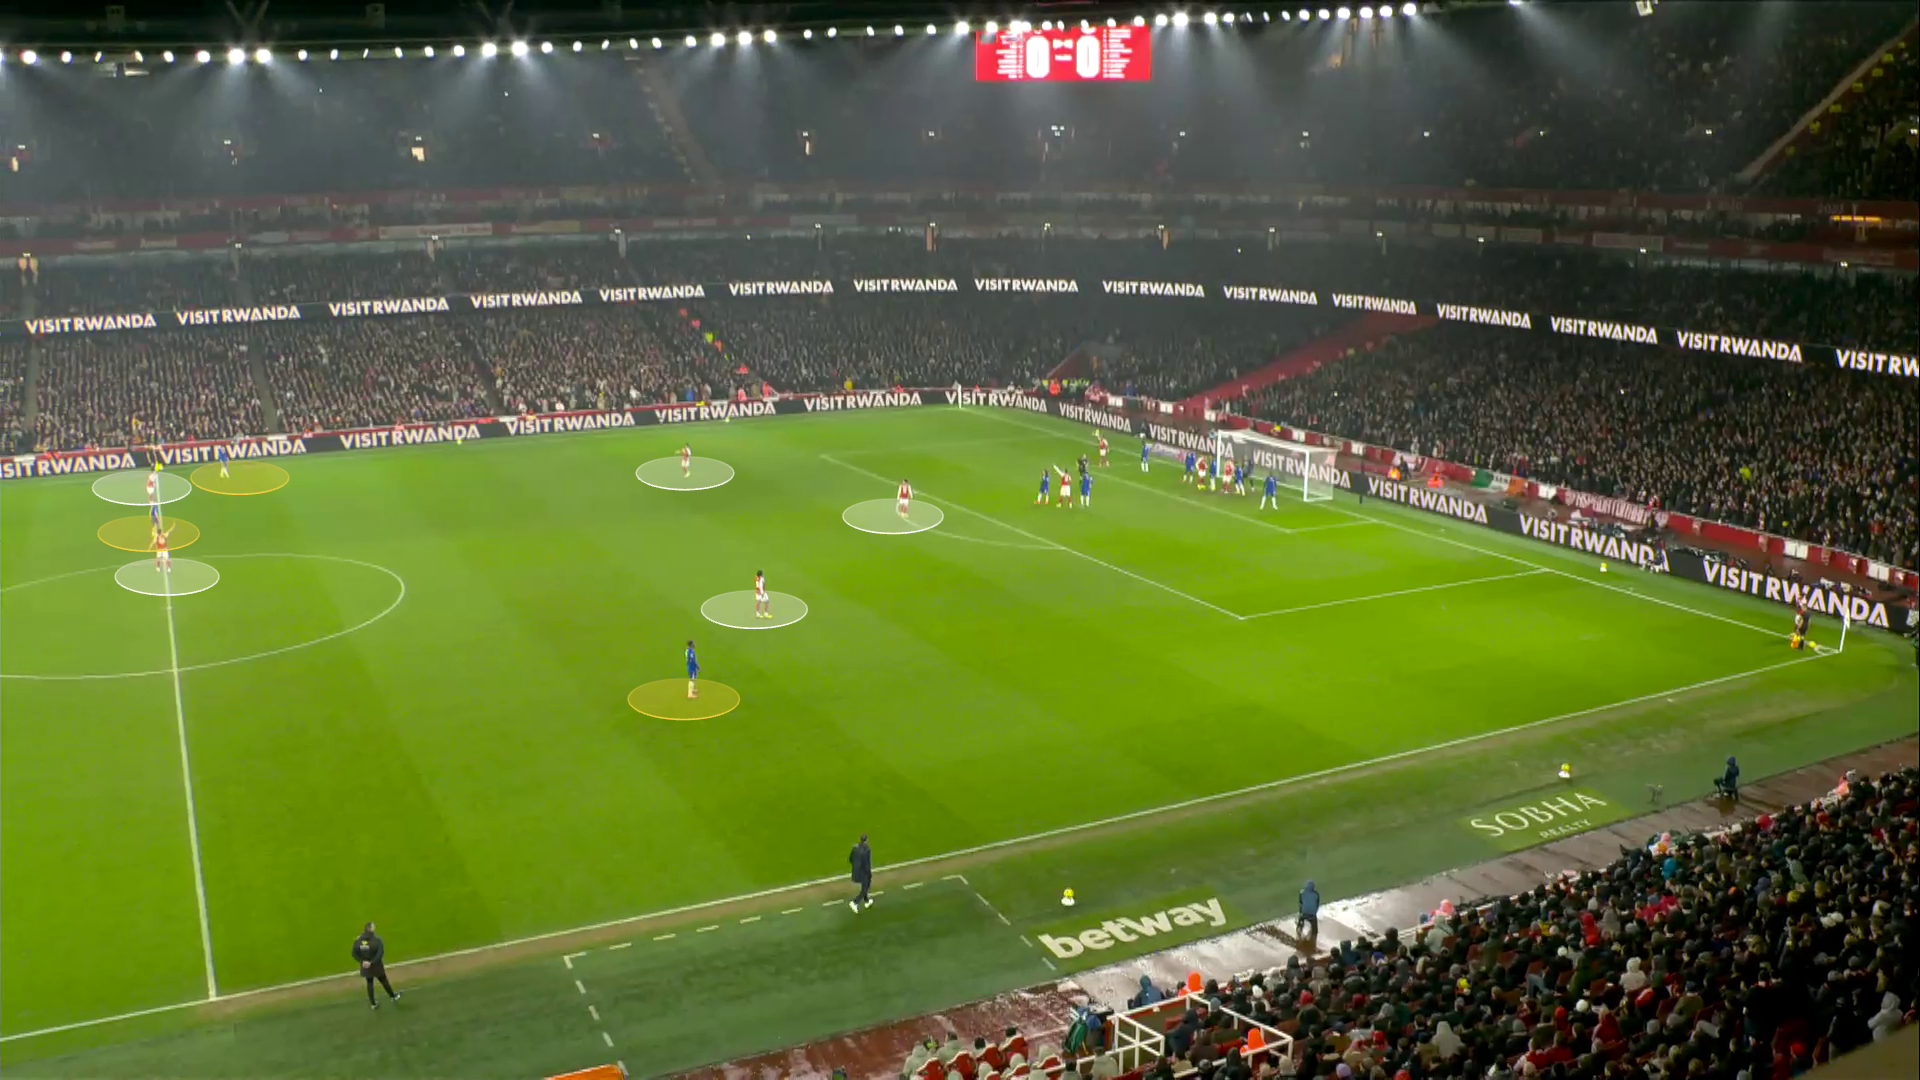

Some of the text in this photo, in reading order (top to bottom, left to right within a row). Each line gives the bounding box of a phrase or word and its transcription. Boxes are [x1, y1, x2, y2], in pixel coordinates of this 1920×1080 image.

[1026, 35, 1050, 78] 0
[1076, 35, 1100, 78] 0
[598, 284, 706, 302] VISIT RWANDA
[728, 280, 834, 297] VISIT RWANDA
[853, 278, 958, 293] VISIT RWANDA
[974, 278, 1079, 293] VISIT RWANDA
[1102, 280, 1205, 298] VISIT RWANDA
[1223, 285, 1318, 306] VISIT RWANDA
[328, 296, 450, 317] VISIT RWANDA
[470, 290, 583, 309] VISIT RWANDA
[1331, 293, 1417, 315] VISIT RWANDA
[26, 313, 157, 334] VISIT RWANDA
[176, 305, 301, 326] VISIT RWANDA
[1436, 303, 1531, 329] VISIT RWANDA
[1550, 316, 1657, 342] VISIT RWANDA
[1676, 330, 1801, 359] VISIT RWANDA
[1836, 348, 1887, 373] VISIT
[655, 401, 776, 423] VISIT RWANDA
[803, 392, 921, 412] VISIT RWANDA
[988, 390, 1048, 413] RWANDA
[505, 412, 636, 436] VISIT RWANDA
[1059, 402, 1133, 432] VISIT RWANDA
[340, 424, 481, 450] VISIT RWANDA
[1149, 423, 1179, 445] VISIT
[37, 453, 135, 477] RWANDA
[160, 446, 211, 465] VISIT
[1252, 449, 1351, 488] VISIT RWANDA
[1368, 477, 1487, 524] VISIT RWANDA
[1519, 513, 1570, 545] VISIT
[1702, 560, 1889, 628] VISIT RWANDA
[1470, 792, 1607, 838] SOBHA
[1038, 897, 1227, 959] betway
